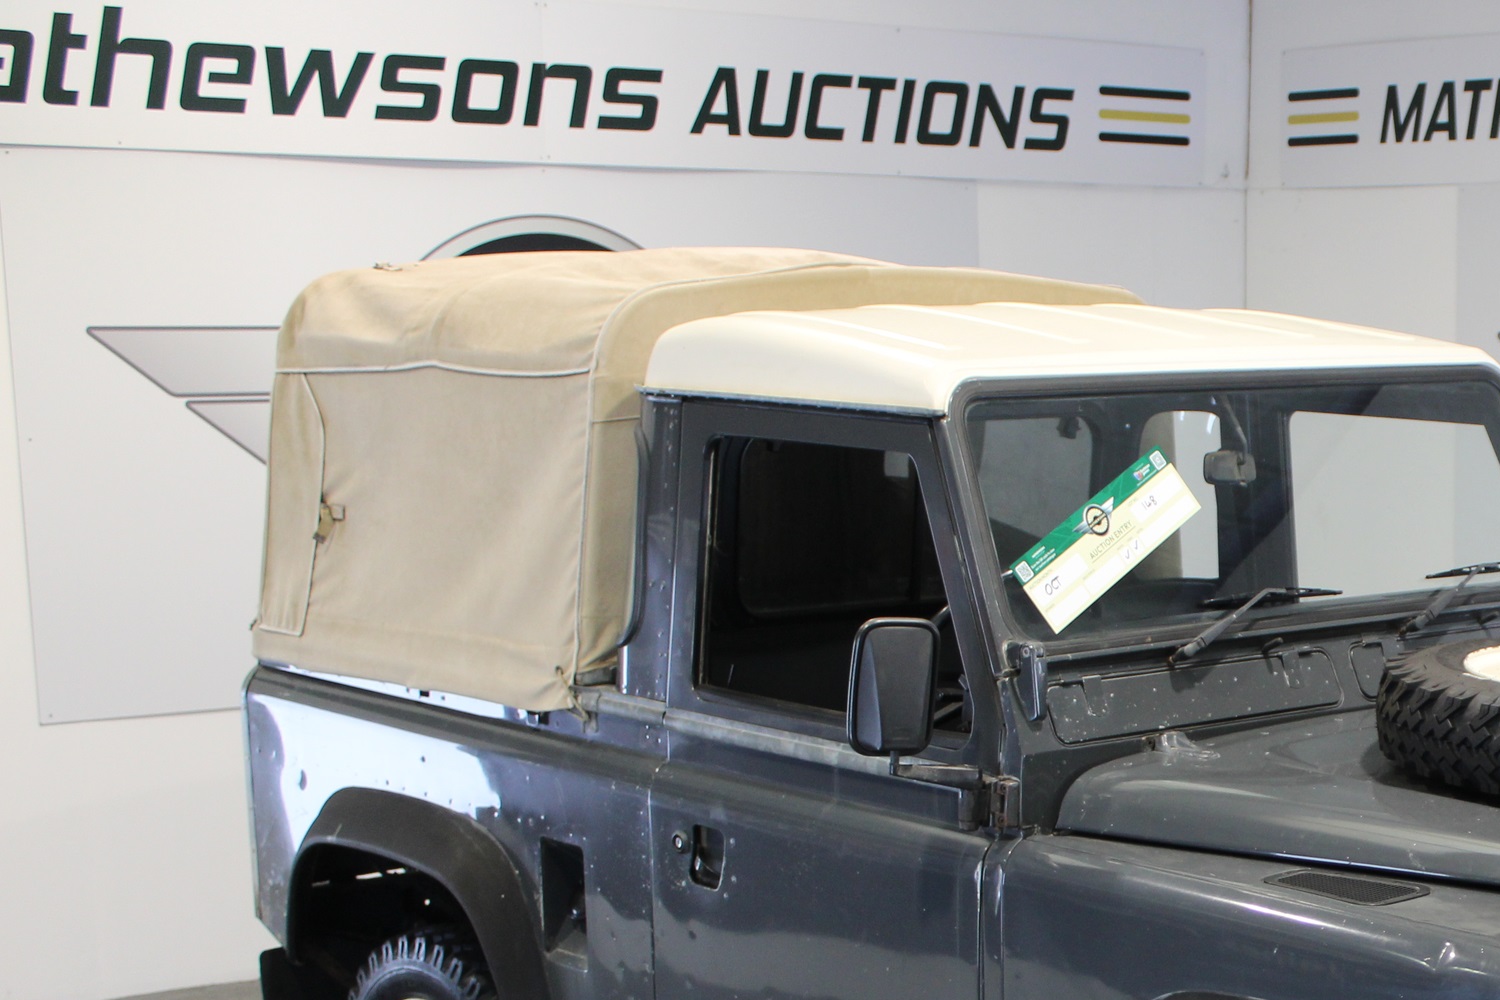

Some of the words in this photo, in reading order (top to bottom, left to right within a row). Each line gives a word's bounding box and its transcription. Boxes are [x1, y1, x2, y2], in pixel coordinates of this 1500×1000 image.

[690, 66, 1075, 152] AUCTIONS
[1089, 534, 1115, 559] AUCTION
[1113, 520, 1133, 539] ENTRY
[1044, 575, 1061, 596] OCT
